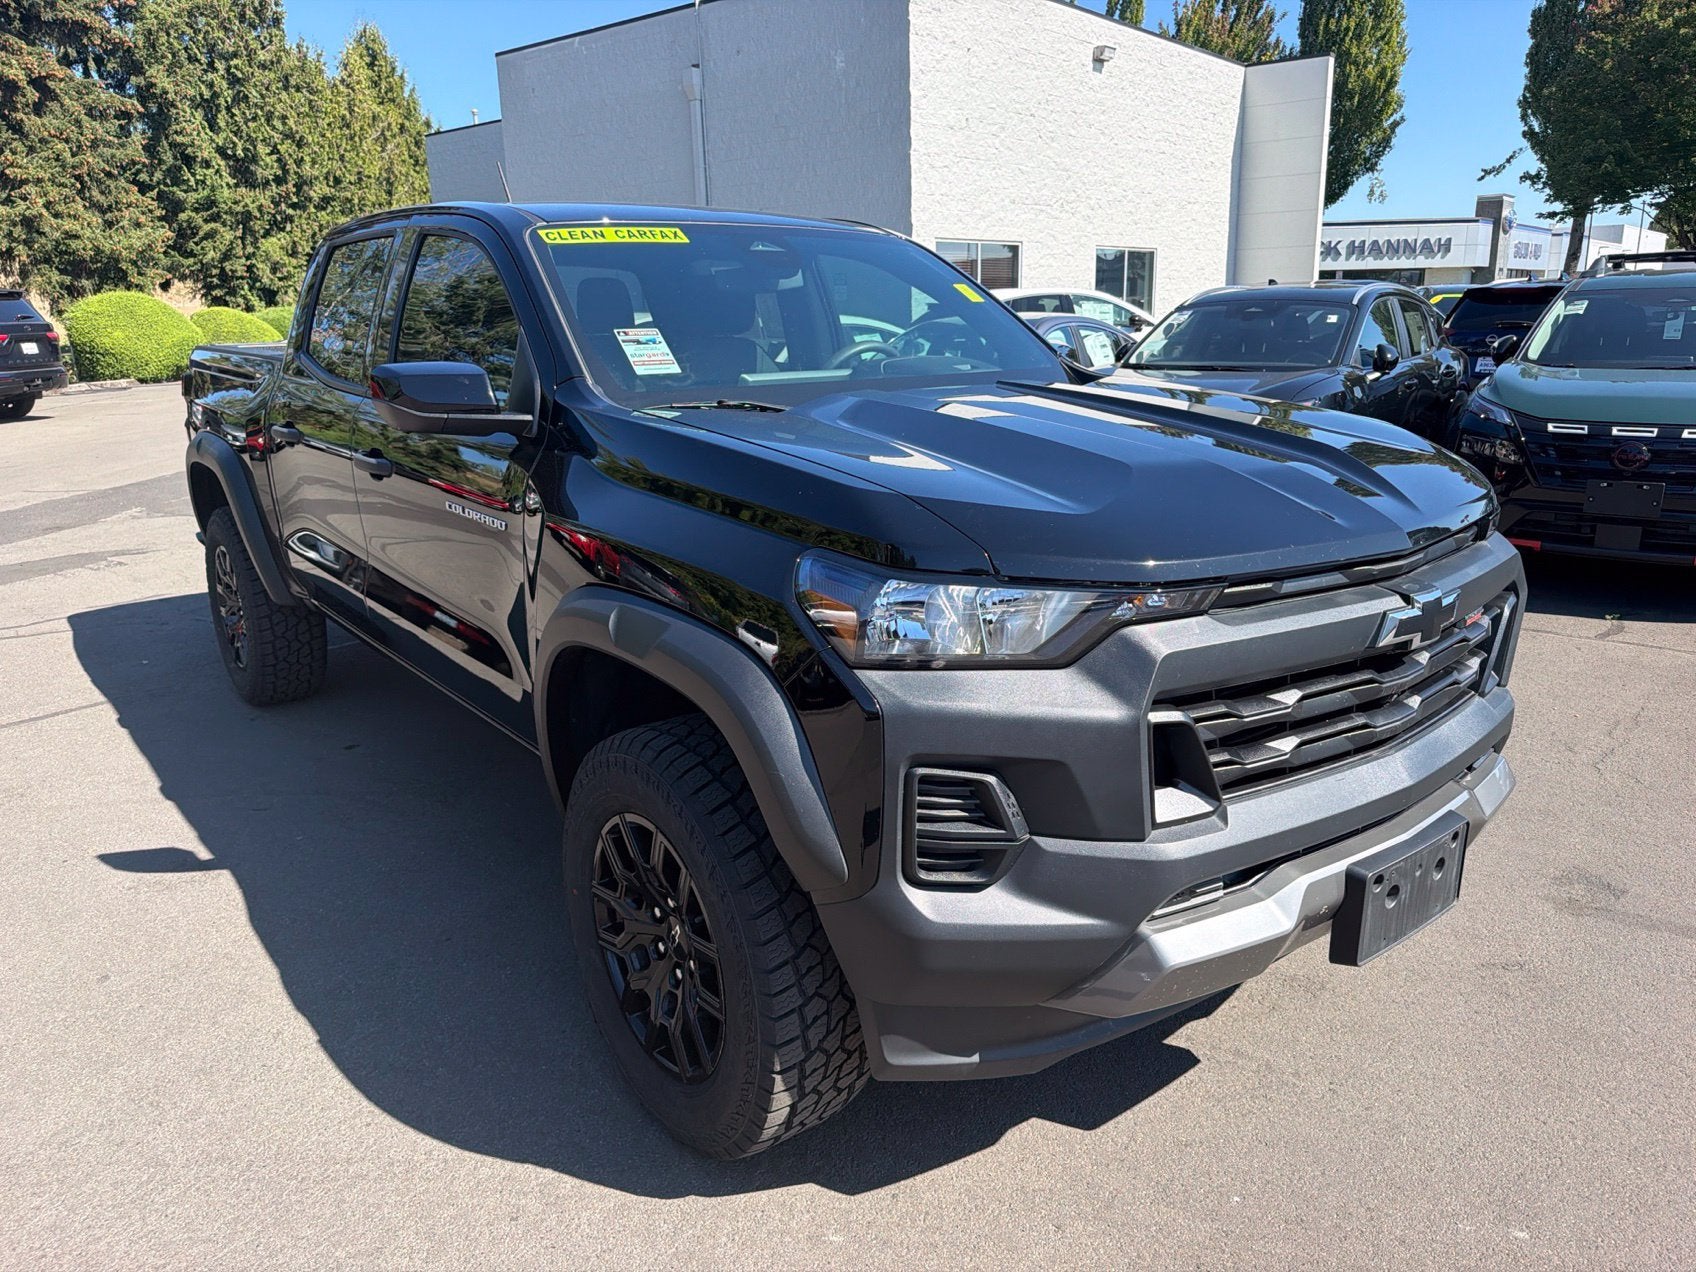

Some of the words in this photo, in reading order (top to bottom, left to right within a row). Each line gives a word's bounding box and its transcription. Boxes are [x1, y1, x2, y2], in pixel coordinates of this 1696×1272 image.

[545, 229, 606, 241] CLEAN
[614, 229, 684, 241] CARFAX
[1346, 237, 1452, 260] HANNAH
[445, 501, 507, 531] COLORADO
